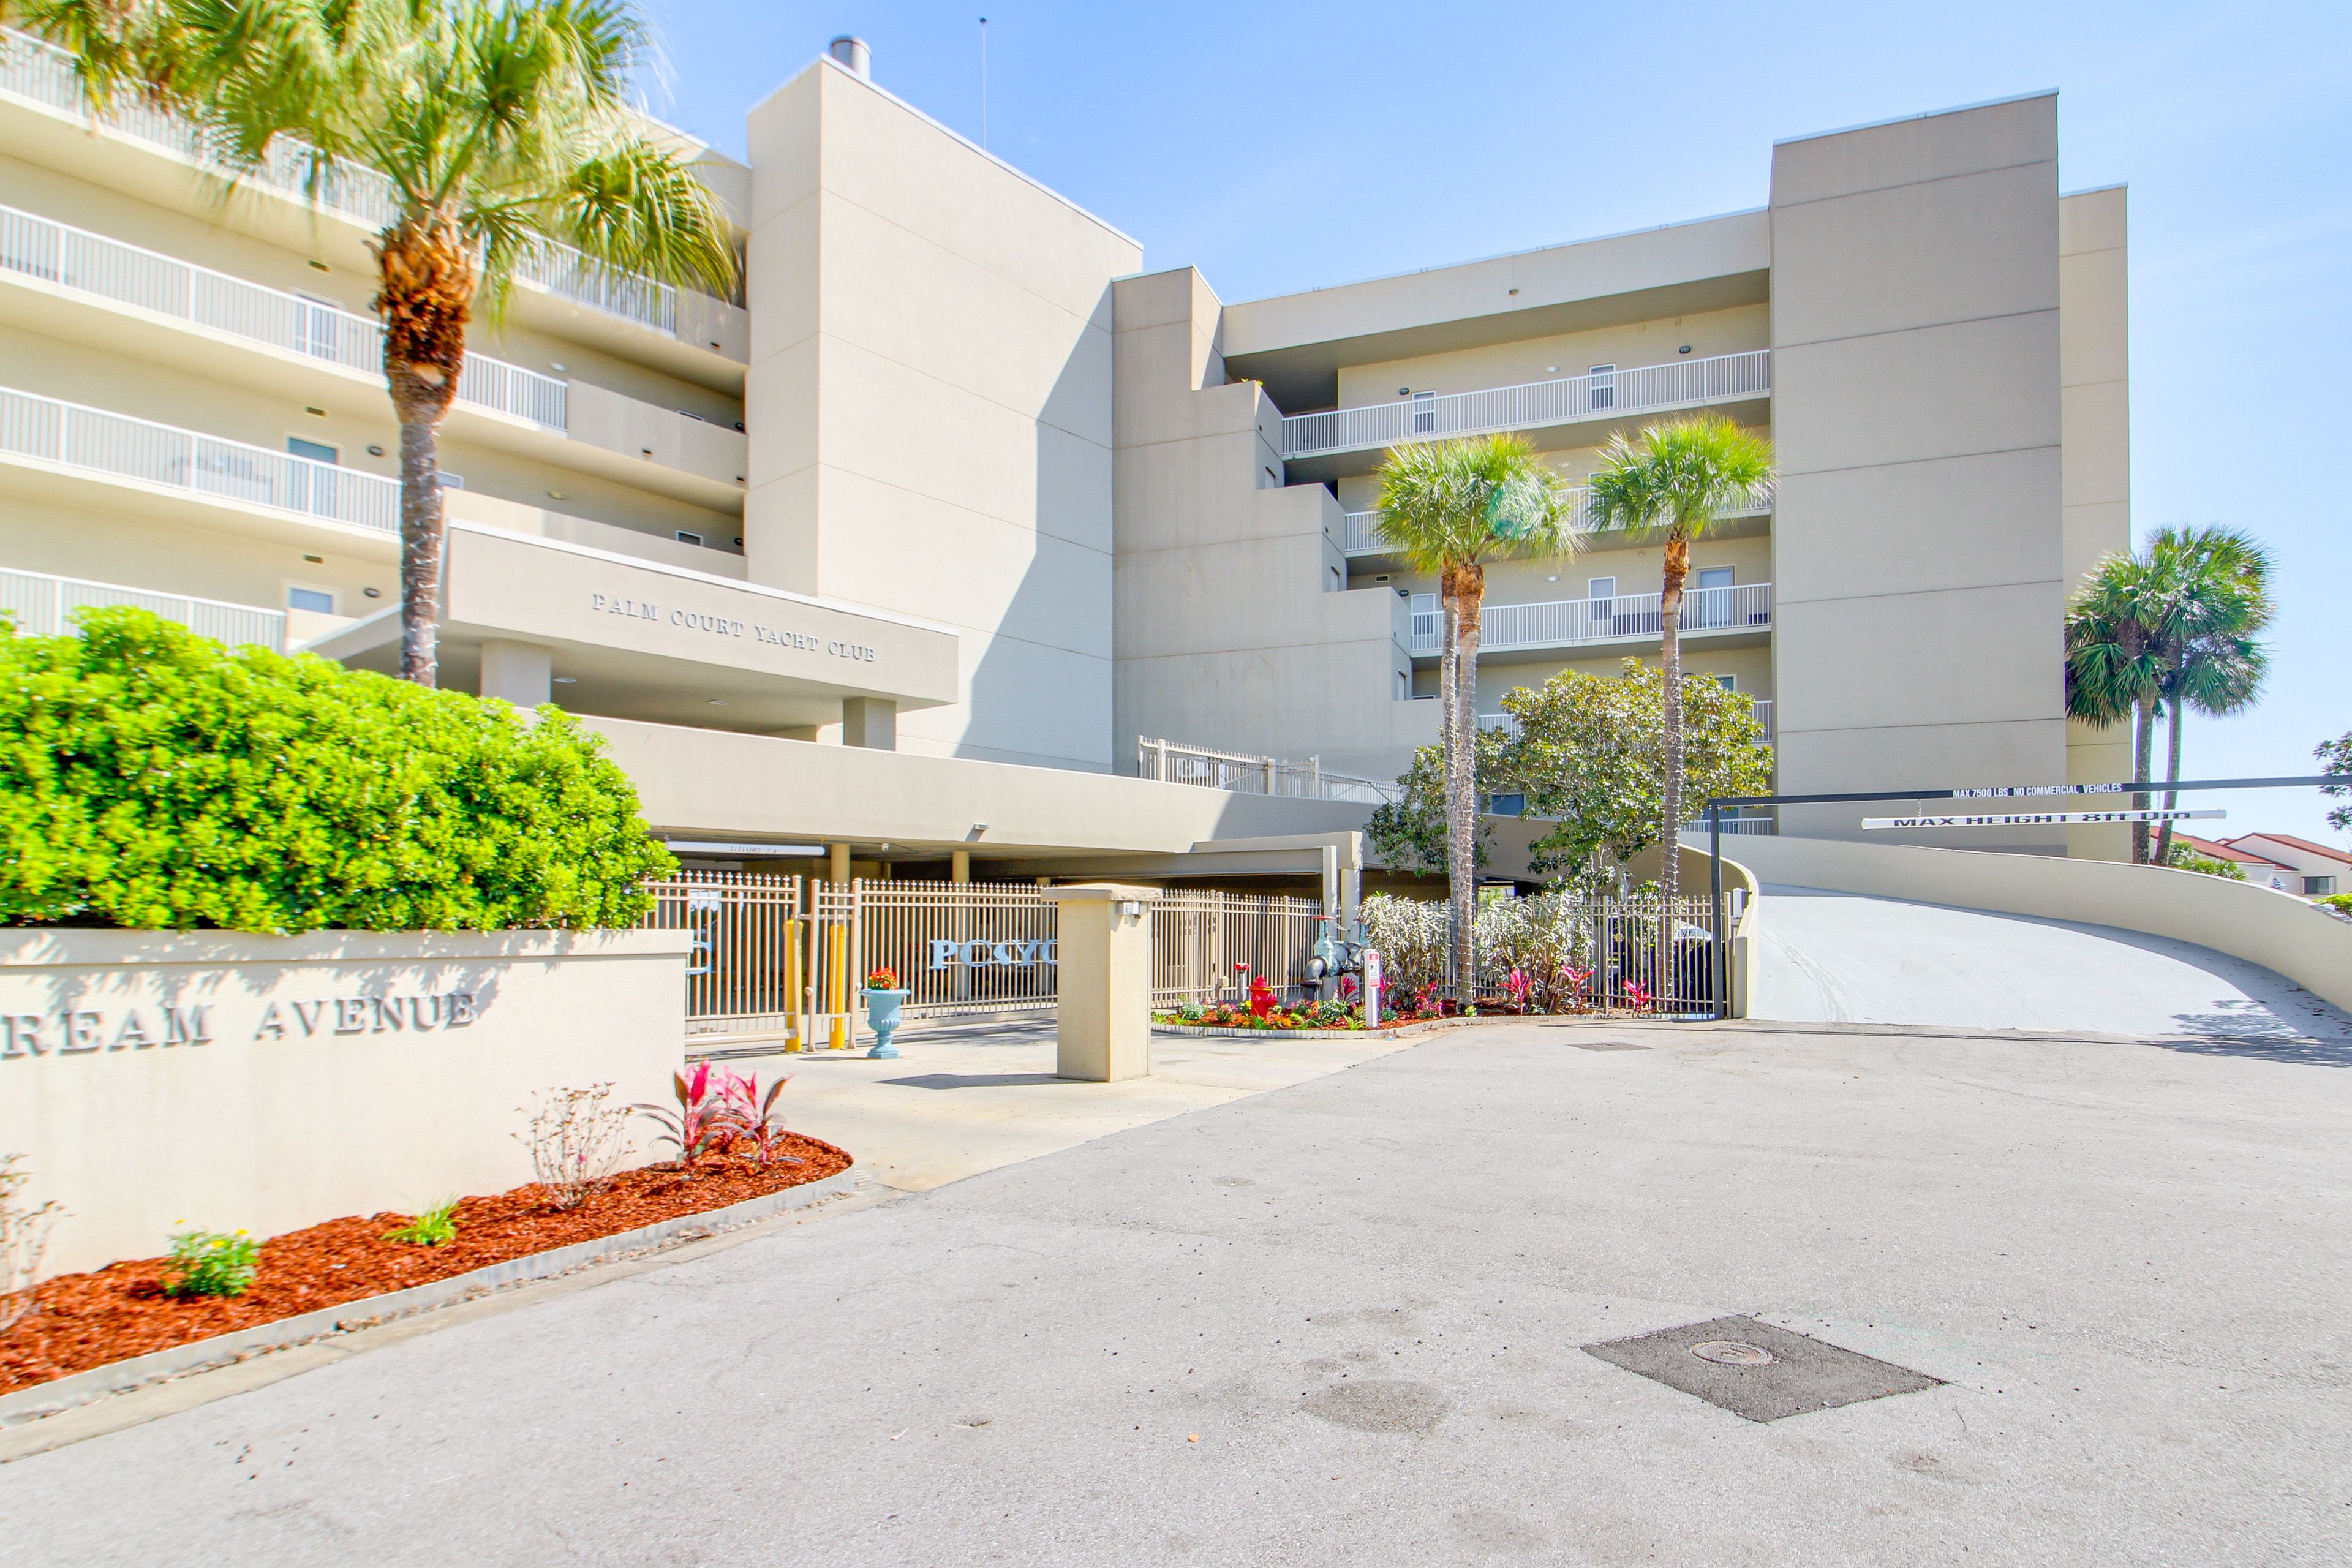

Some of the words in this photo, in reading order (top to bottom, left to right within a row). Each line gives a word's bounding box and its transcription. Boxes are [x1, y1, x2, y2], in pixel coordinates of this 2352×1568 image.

[593, 594, 659, 620] PALM
[671, 611, 744, 637] COURT
[755, 625, 818, 651] YACHT
[828, 640, 875, 662] CLUB
[1952, 789, 1970, 799] MAX
[1972, 788, 1991, 798] 7500
[1993, 787, 2008, 797] LBS
[2013, 786, 2025, 796] NO
[2026, 785, 2079, 796] COMMERCIAL
[2082, 783, 2123, 794] VEHICLES
[1894, 818, 1955, 827] MAX
[1966, 815, 2071, 824] HEIGHT
[2082, 813, 2130, 822] 8ft
[0, 1003, 215, 1060] REAM
[254, 991, 477, 1041] AVENUE
